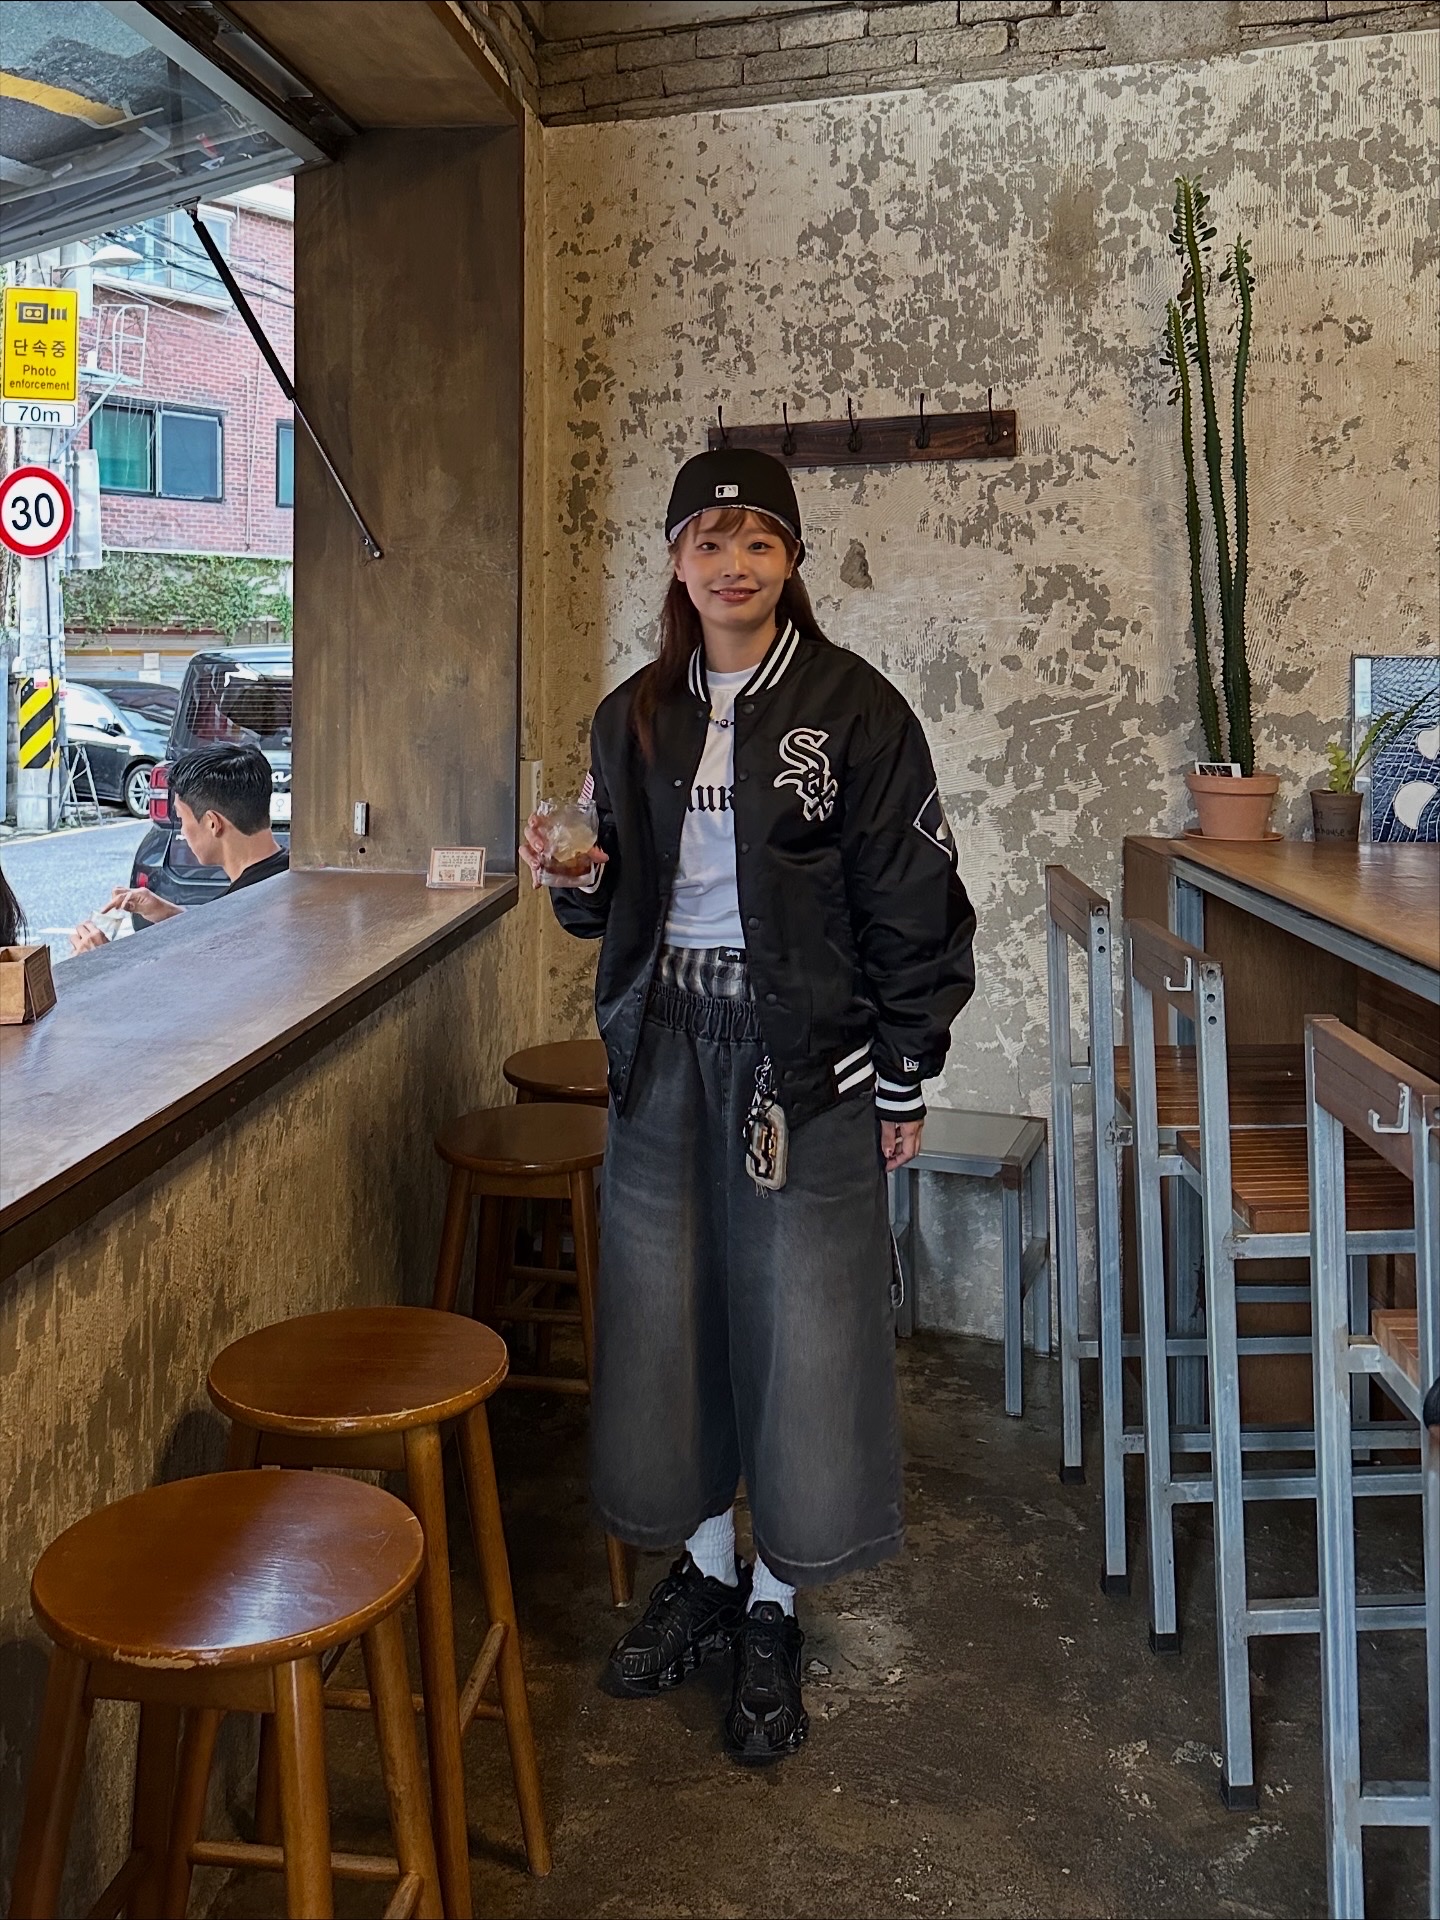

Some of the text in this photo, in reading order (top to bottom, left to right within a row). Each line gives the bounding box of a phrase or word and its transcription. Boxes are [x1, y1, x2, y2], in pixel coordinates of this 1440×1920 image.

[14, 339, 67, 358] 단속중
[23, 364, 57, 377] Photo
[9, 379, 70, 391] enforcement
[18, 405, 61, 423] 70m
[11, 492, 55, 531] 30
